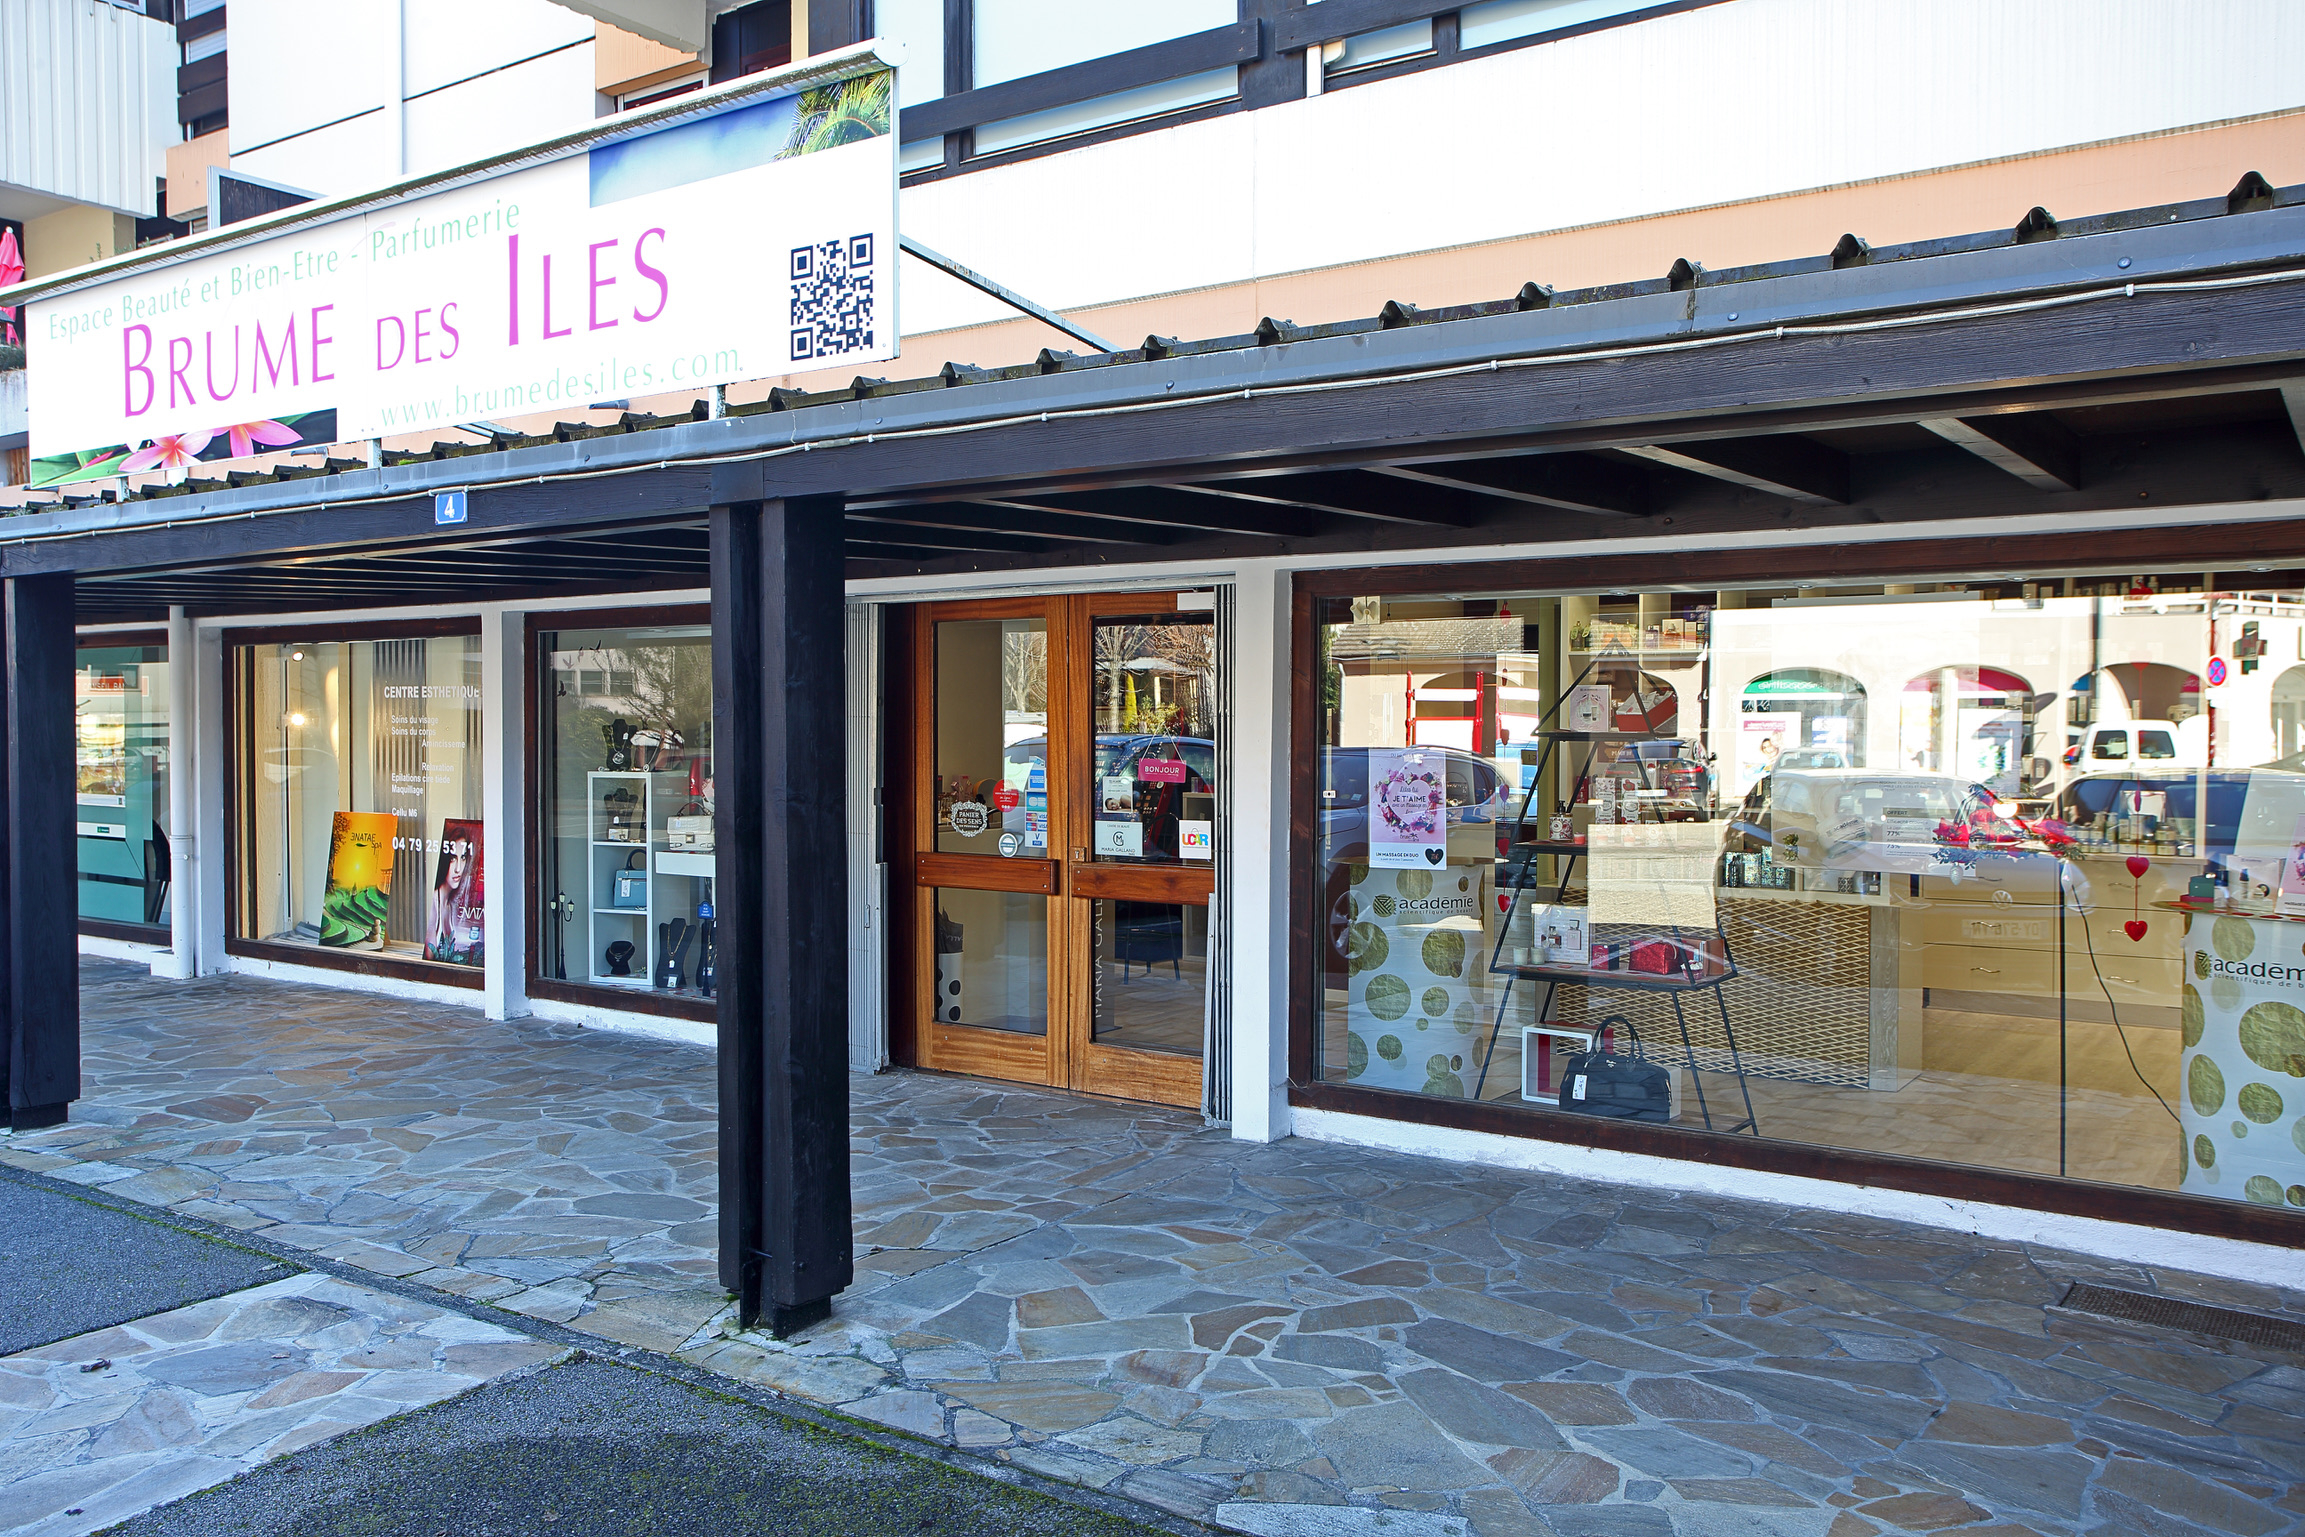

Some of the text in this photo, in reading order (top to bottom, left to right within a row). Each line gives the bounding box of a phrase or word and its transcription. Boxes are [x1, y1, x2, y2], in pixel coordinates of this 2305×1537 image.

[50, 306, 113, 344] Espace
[122, 277, 191, 322] Beauté
[201, 275, 219, 303] et
[231, 250, 339, 296] Bien-Etre
[373, 198, 520, 261] Parfumerie
[123, 227, 668, 417] BRUME DES ILES
[381, 349, 738, 428] www.brumedesiles.com
[444, 495, 455, 518] 4
[384, 685, 480, 699] CENTRE ESTHETIQUE
[391, 715, 439, 726] Soins du visage
[391, 727, 436, 738] Soins du corps
[422, 762, 454, 772] Relaxation
[1144, 766, 1180, 774] BONJOUR
[391, 772, 421, 783] Epilations
[422, 774, 434, 783] cire
[391, 784, 424, 796] Maquillage
[1393, 795, 1427, 803] JE T'AIME
[391, 807, 418, 817] Cellu M6
[392, 836, 474, 856] 04 79 25 53 71
[1182, 834, 1209, 846] UCAR
[1095, 955, 1103, 1018] MARIA
